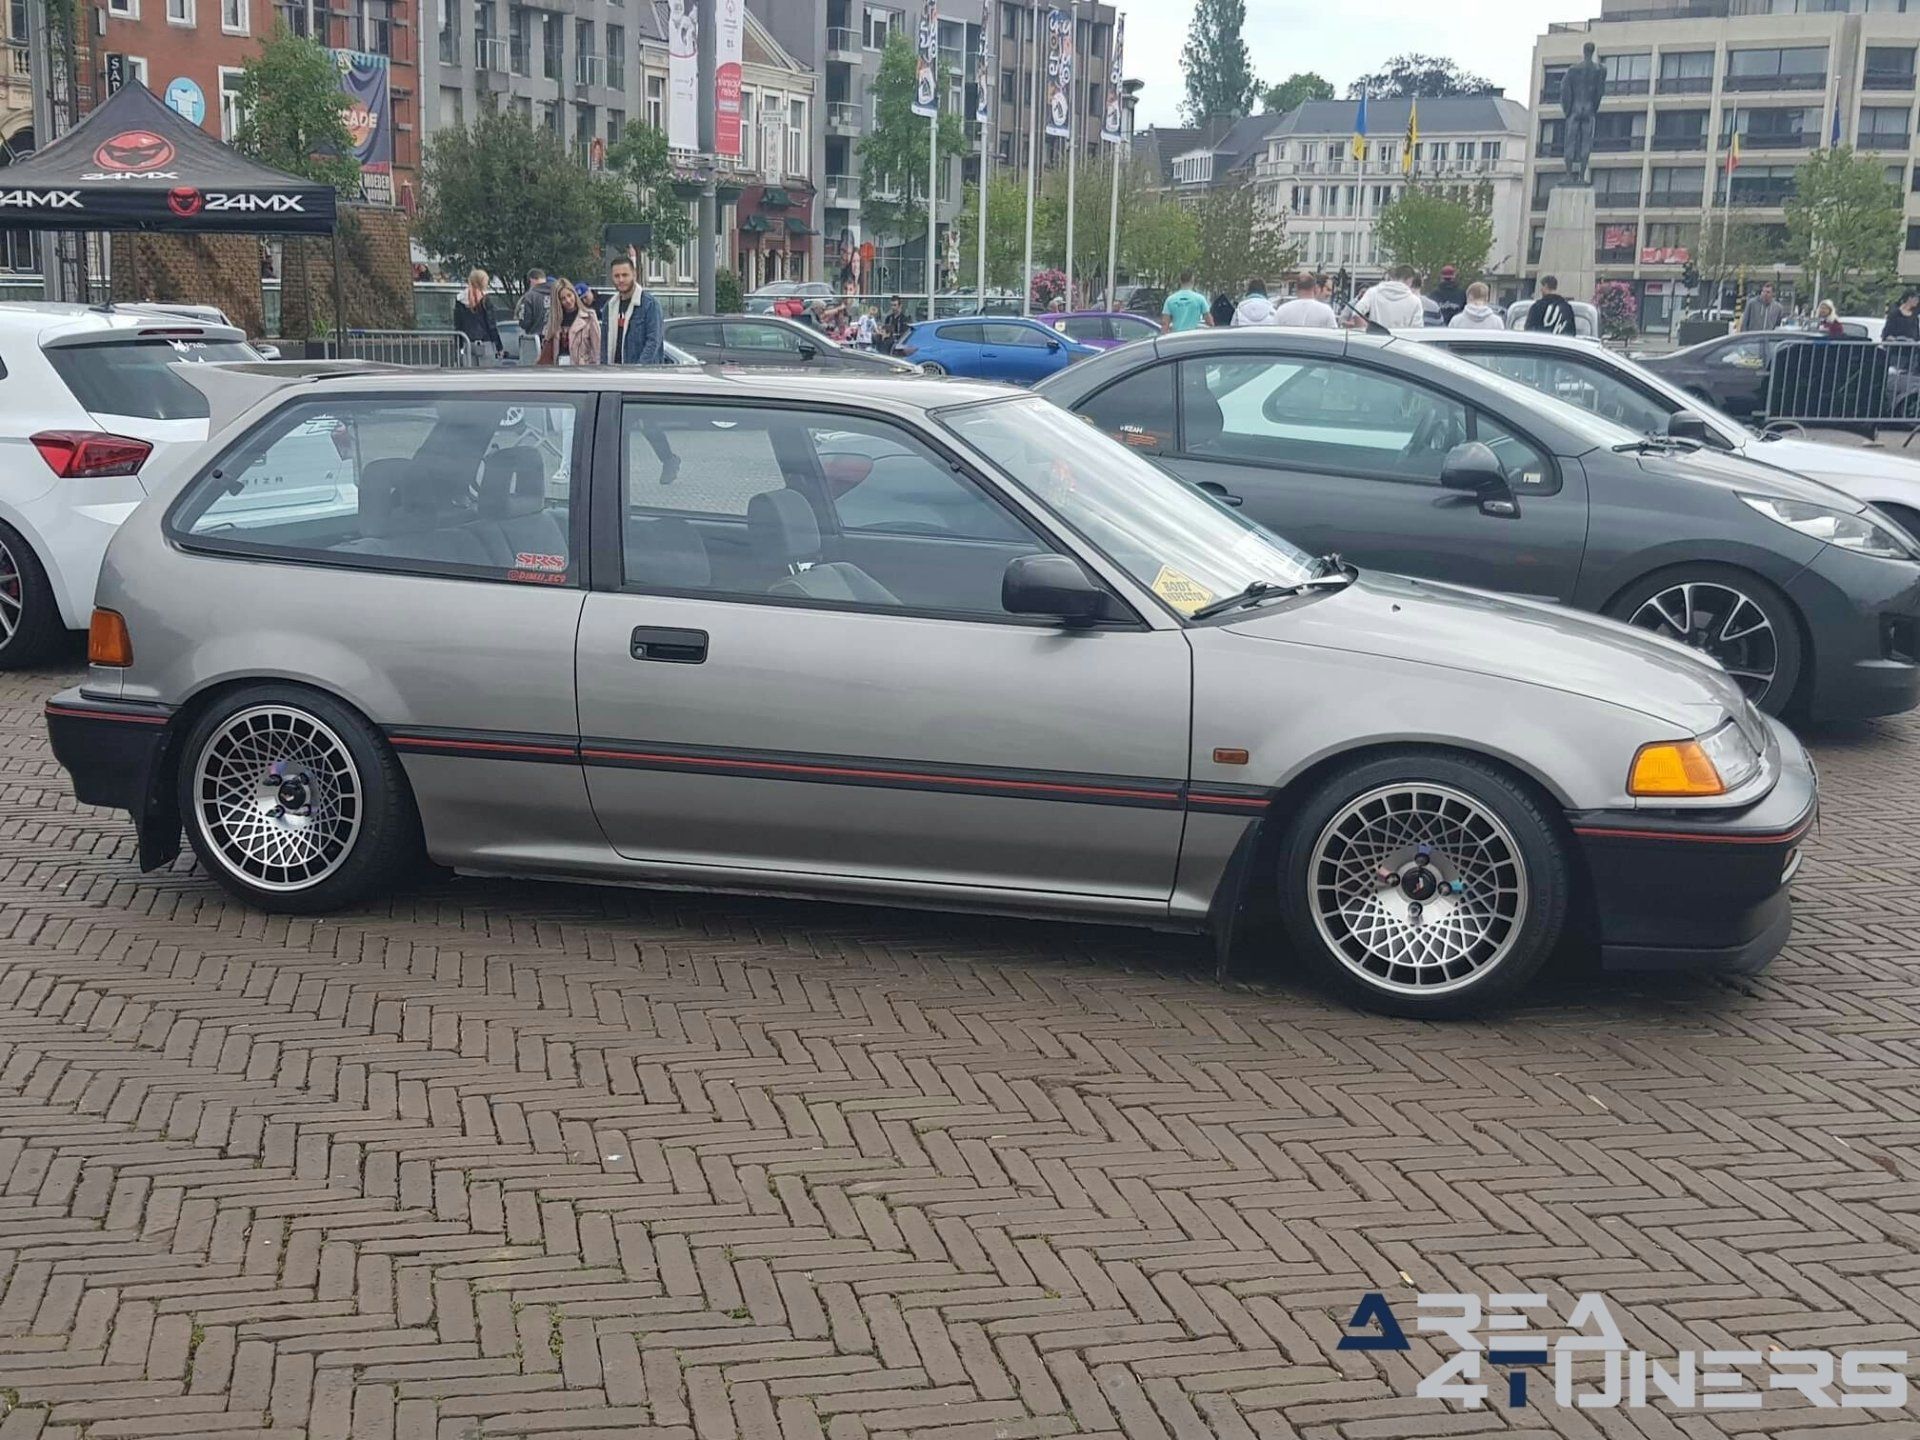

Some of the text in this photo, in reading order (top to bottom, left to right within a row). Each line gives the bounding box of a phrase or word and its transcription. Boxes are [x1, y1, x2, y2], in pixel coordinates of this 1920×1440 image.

[79, 172, 179, 181] 24MX
[0, 190, 84, 208] 4MX
[205, 193, 305, 212] 24MX
[515, 552, 566, 568] SRS
